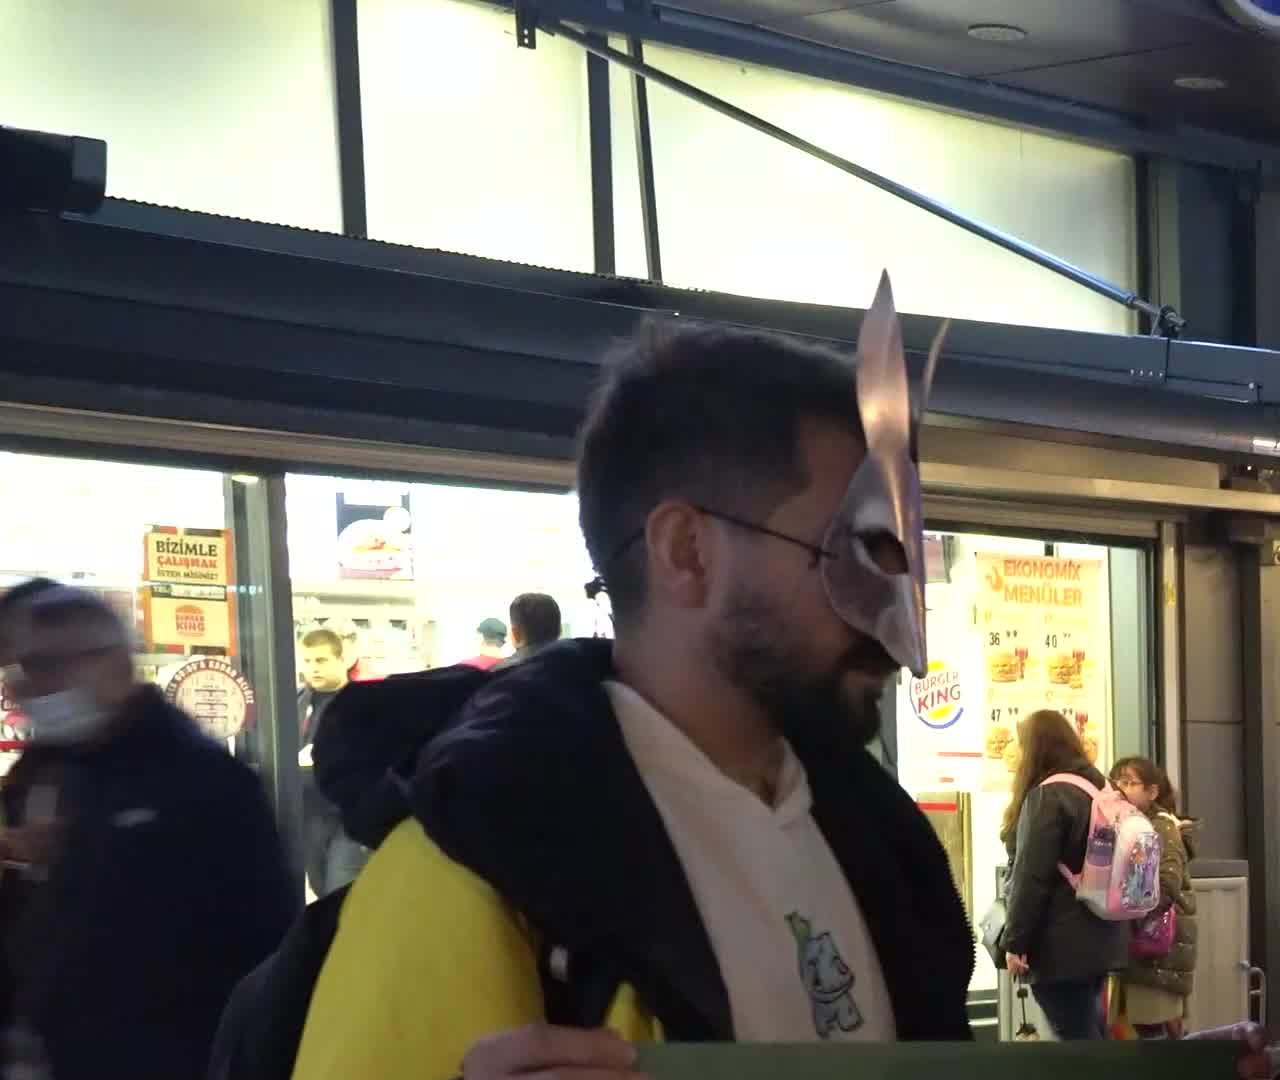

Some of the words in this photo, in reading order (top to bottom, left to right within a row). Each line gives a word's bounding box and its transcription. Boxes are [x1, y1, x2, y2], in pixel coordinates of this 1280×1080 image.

[156, 537, 218, 558] BİZİMLE
[1003, 559, 1082, 582] EKONOMİX
[1003, 582, 1083, 608] MENÜLER
[176, 621, 205, 632] KING
[914, 671, 960, 693] BURGER
[917, 684, 961, 714] KING
